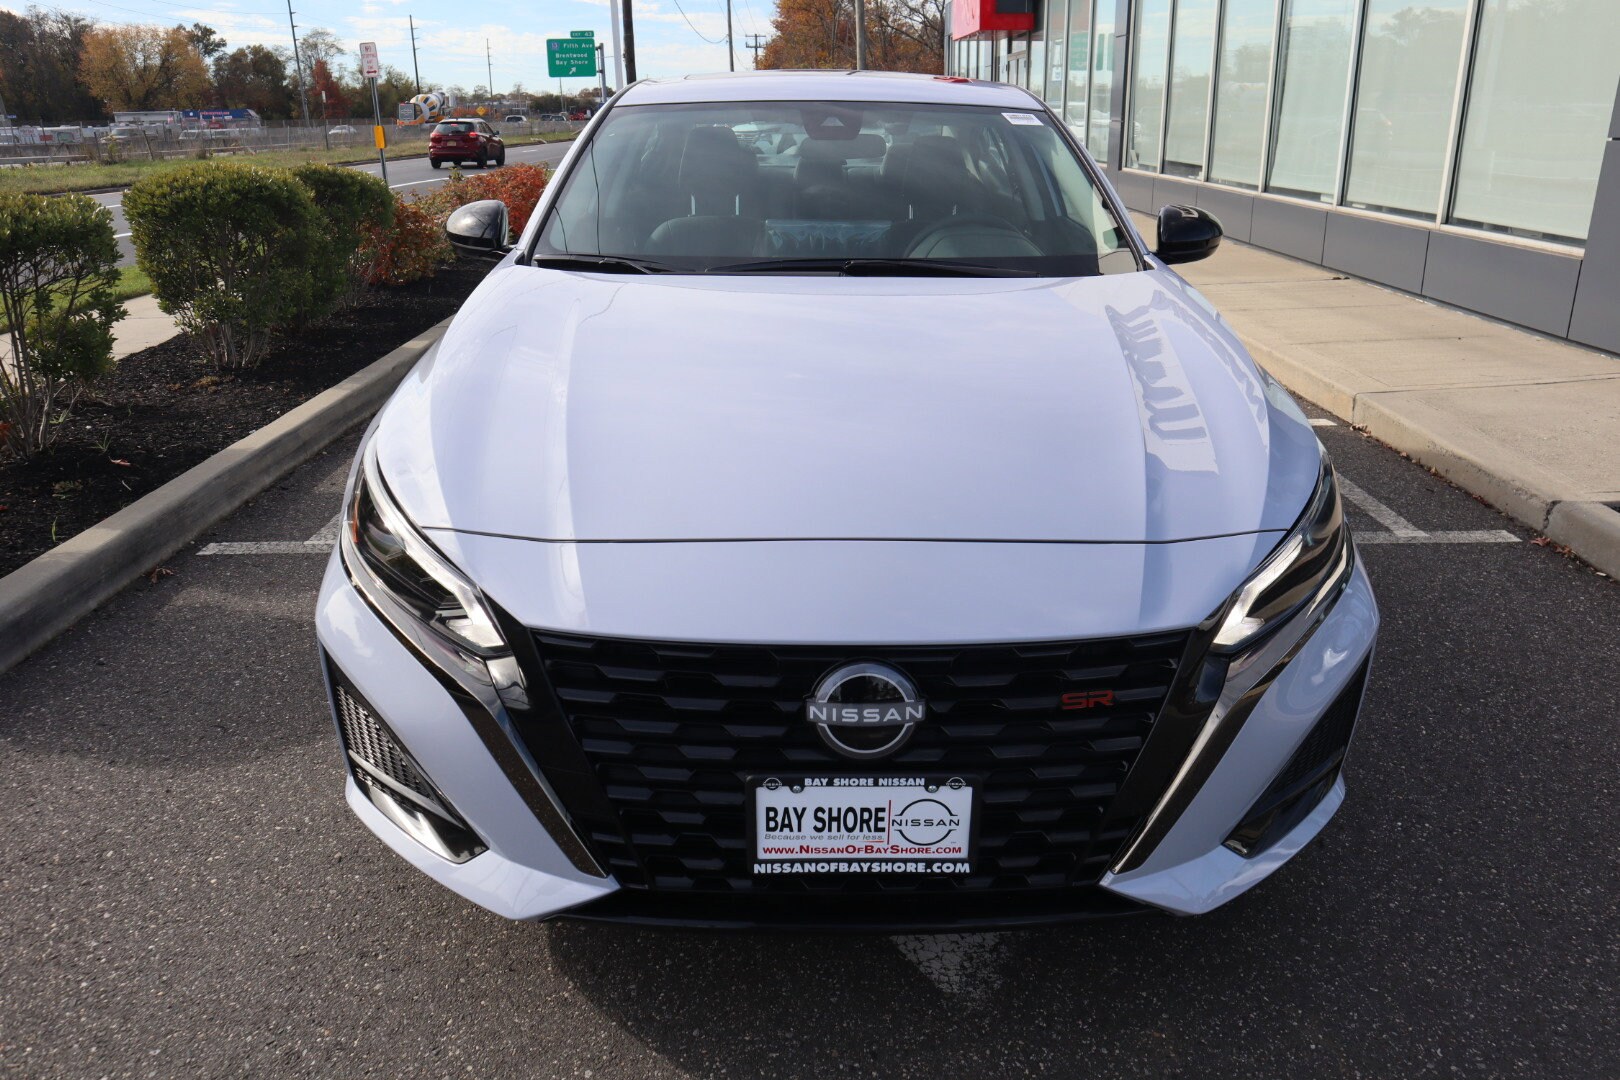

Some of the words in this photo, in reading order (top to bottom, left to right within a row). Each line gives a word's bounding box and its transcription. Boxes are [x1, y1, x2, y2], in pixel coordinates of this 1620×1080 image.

[1061, 690, 1114, 710] SR
[809, 705, 923, 723] NISSAN
[804, 777, 829, 787] BAY
[833, 777, 874, 787] SHORE
[878, 777, 926, 787] NISSAN
[765, 806, 807, 833] BAY
[812, 806, 886, 834] SHORE
[891, 818, 960, 827] NISSAN
[764, 833, 807, 841] Because
[827, 833, 844, 841] sell
[847, 833, 861, 841] for
[753, 862, 971, 874] NISSANOFBAYSHORE.COM
